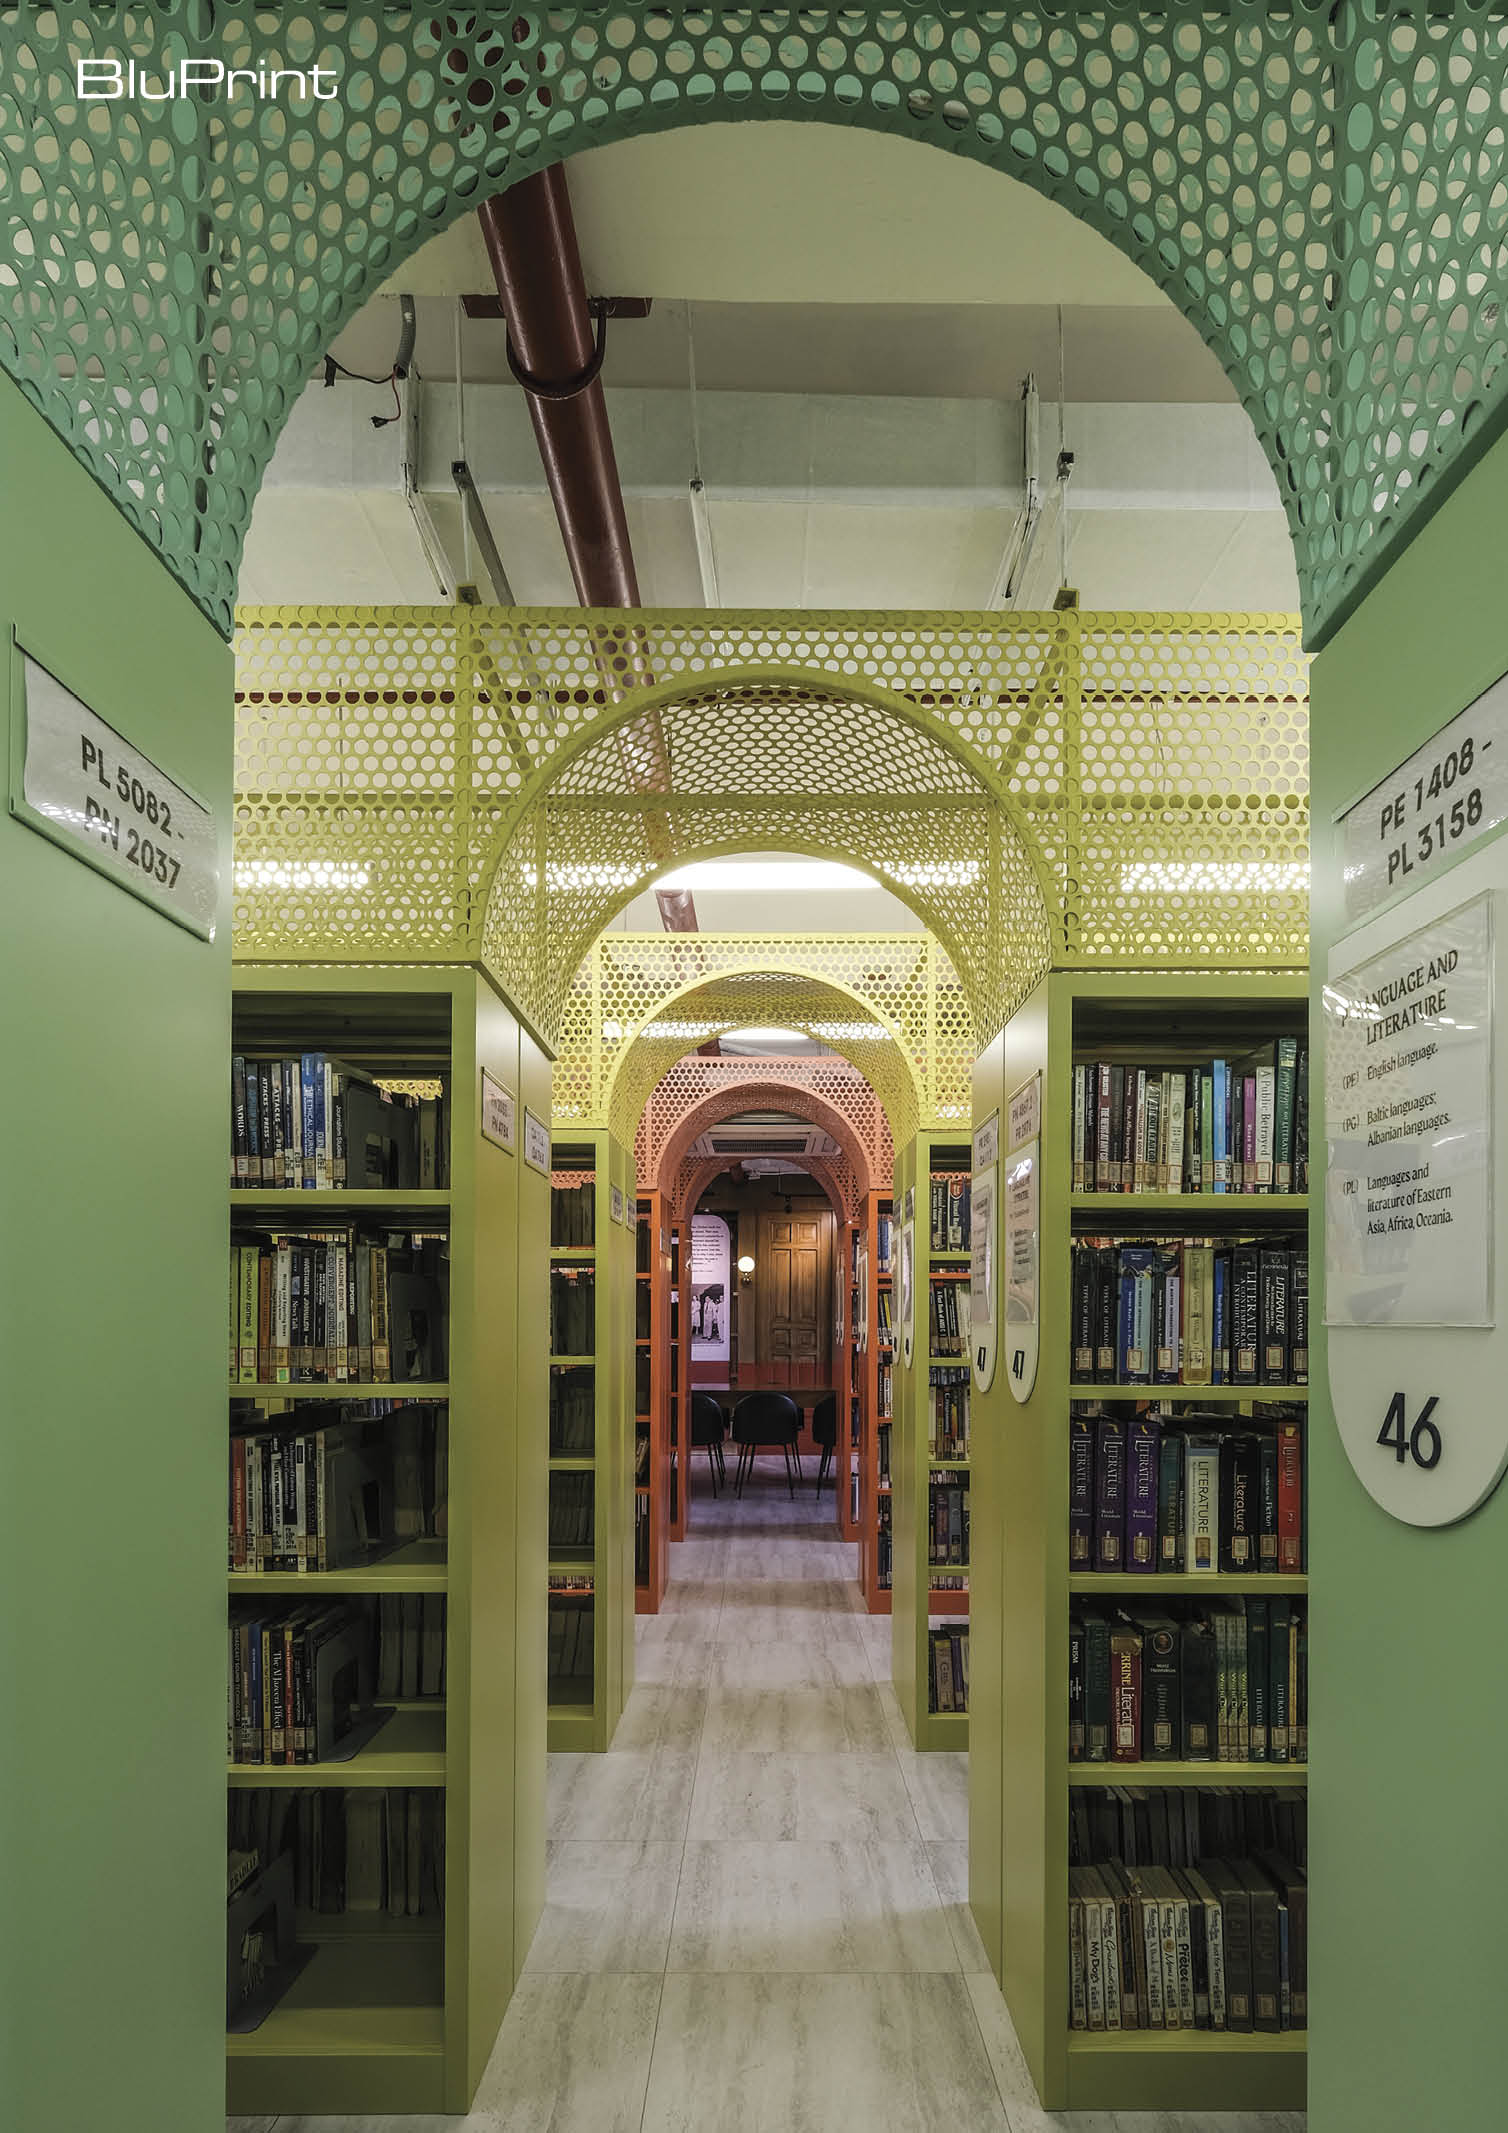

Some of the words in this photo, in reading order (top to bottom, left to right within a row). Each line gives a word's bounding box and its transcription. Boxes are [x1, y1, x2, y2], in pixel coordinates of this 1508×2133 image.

[81, 734, 111, 790] PL
[117, 767, 172, 836] 5082
[1380, 792, 1405, 840] PE
[1414, 737, 1474, 813] 1408
[85, 796, 120, 851] PN
[126, 827, 182, 890] 2037
[1388, 842, 1414, 885] PL
[1417, 788, 1483, 862] 3158
[1359, 966, 1424, 1011] NGUAGE
[1427, 950, 1459, 985] AND
[1366, 989, 1447, 1046] LITERATURE
[1367, 1060, 1396, 1080] English
[1397, 1042, 1438, 1066] language.
[1367, 1106, 1389, 1125] Baltic
[1367, 1127, 1402, 1148] Albanian
[1367, 1170, 1411, 1191] Languages
[1412, 1162, 1429, 1180] and
[1367, 1196, 1406, 1213] literature
[1406, 1190, 1417, 1206] of
[1417, 1185, 1452, 1203] Eastern
[1367, 1220, 1387, 1235] Asia,
[1387, 1216, 1415, 1232] Africa,
[1416, 1208, 1454, 1228] Oceania.
[1246, 1271, 1257, 1352] LITERATUR
[1275, 1276, 1285, 1334] LITERATURE
[1012, 1349, 1025, 1380] 47
[1376, 1391, 1442, 1469] 46
[1072, 1440, 1091, 1496] LITERATURE
[1103, 1441, 1123, 1497] LITERATURE
[1134, 1440, 1154, 1497] LITERATURE
[1198, 1462, 1209, 1533] LITERATURE
[1236, 1474, 1248, 1532] Literature
